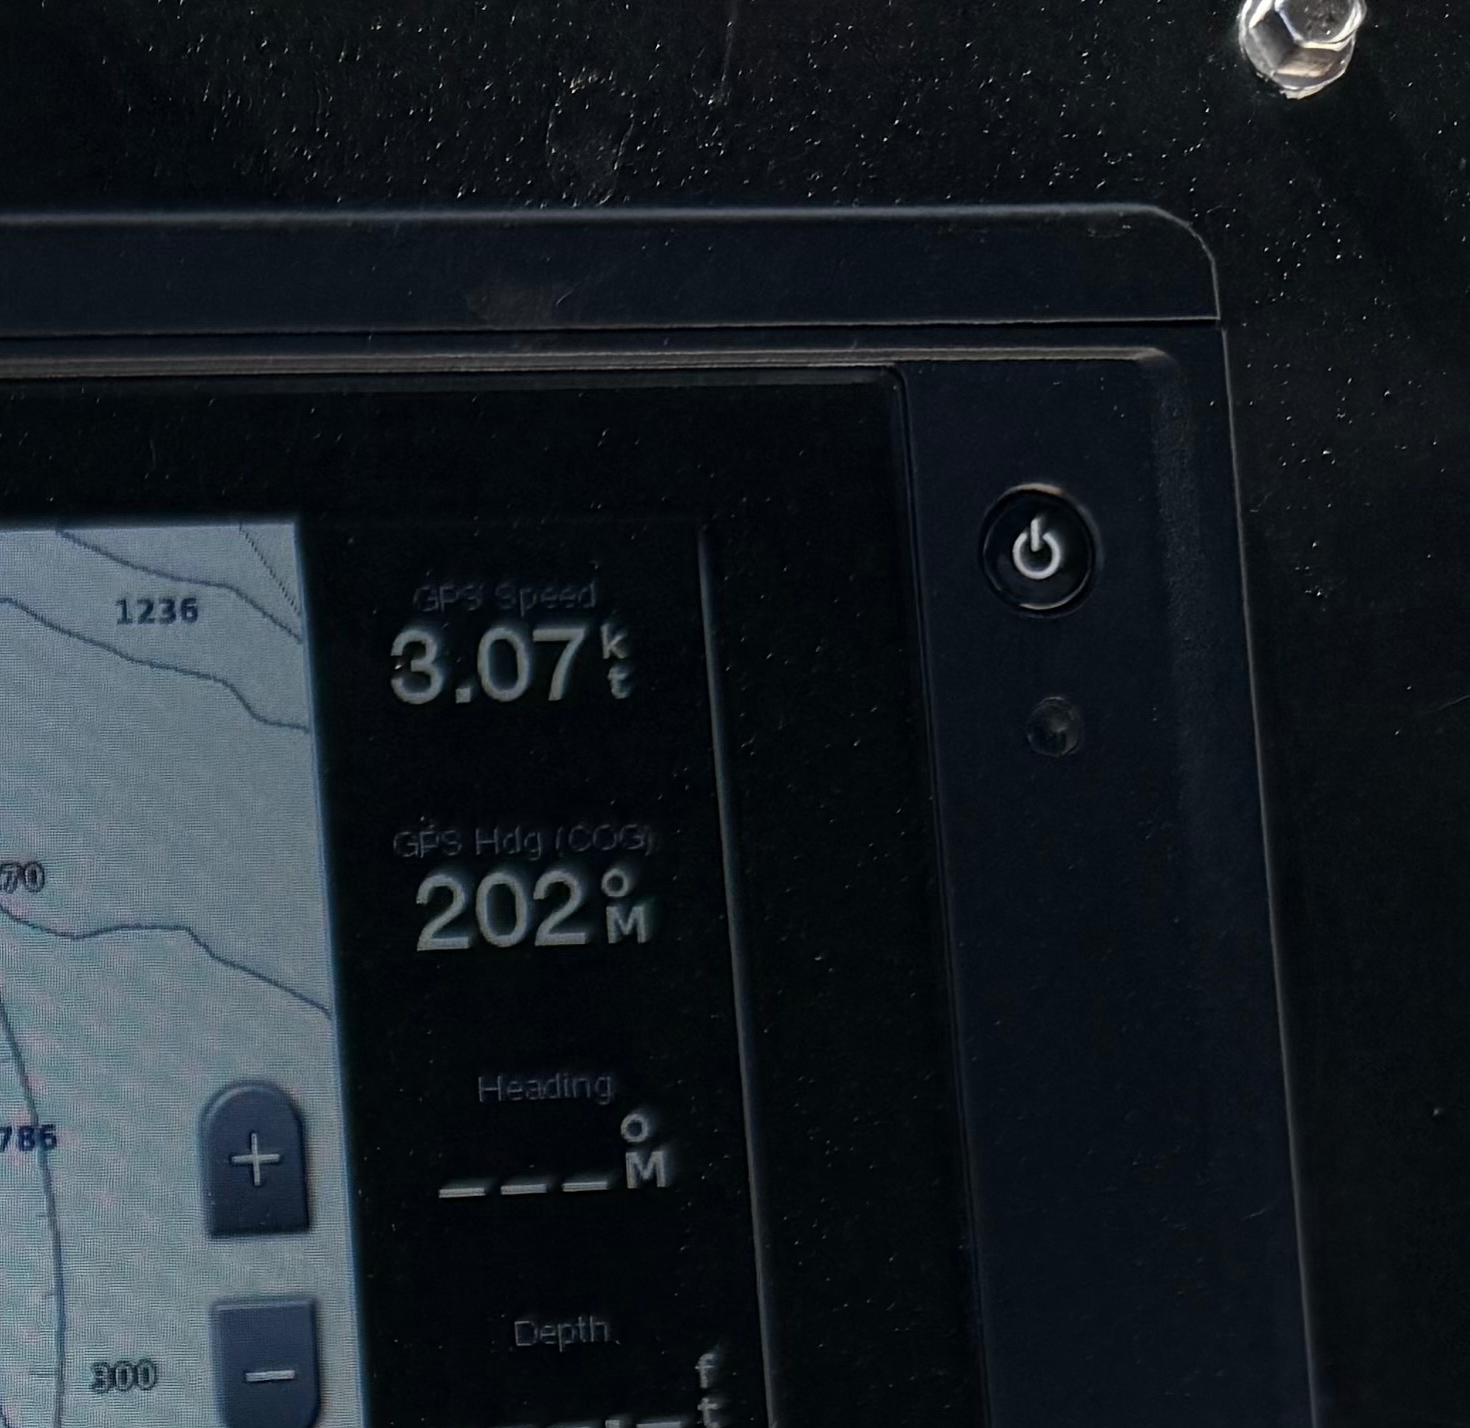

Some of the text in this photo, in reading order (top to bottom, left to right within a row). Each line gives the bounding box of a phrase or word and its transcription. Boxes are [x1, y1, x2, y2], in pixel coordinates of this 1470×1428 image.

[115, 598, 199, 626] 1236
[413, 580, 597, 617] GPS Speed
[390, 627, 586, 705] 3.07
[393, 822, 655, 861] GPS Hdg (COG)
[415, 871, 587, 952] 202
[478, 1072, 612, 1105] Heading
[514, 1315, 612, 1352] Depth
[90, 1361, 158, 1393] 300
